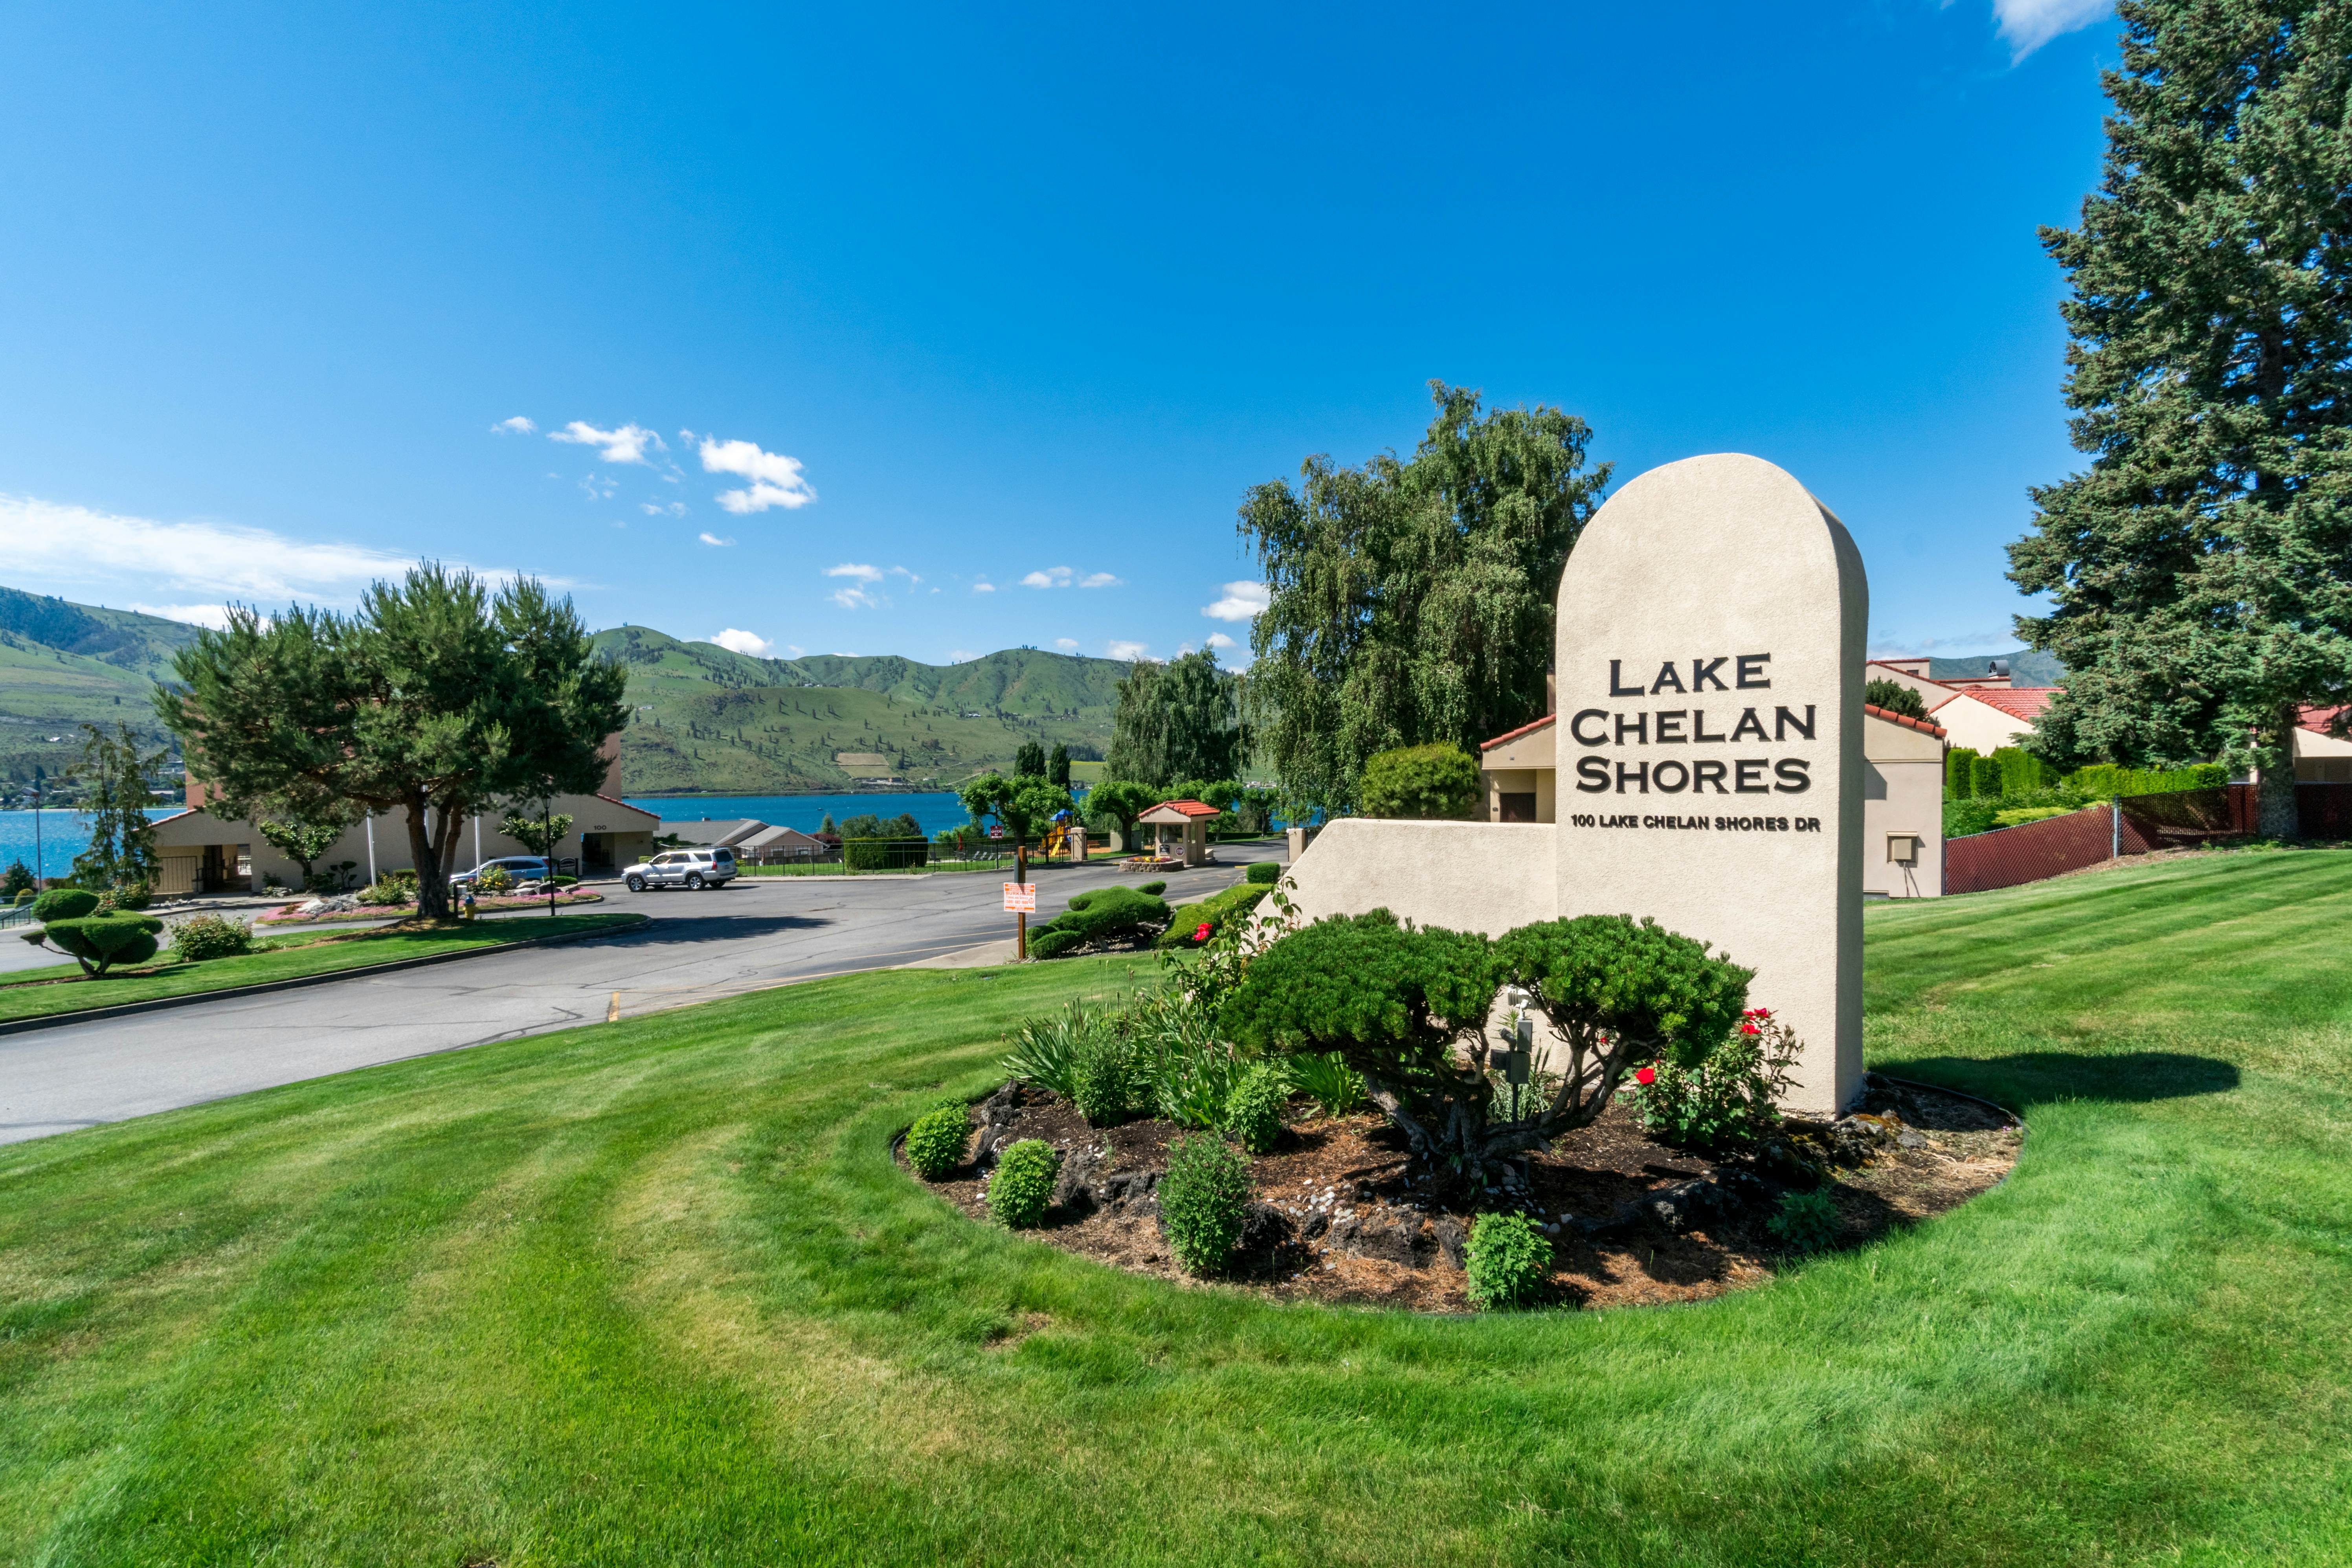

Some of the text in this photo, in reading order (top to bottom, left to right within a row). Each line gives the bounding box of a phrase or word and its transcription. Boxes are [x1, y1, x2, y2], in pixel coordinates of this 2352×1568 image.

[1609, 652, 1770, 696] LAKE
[1571, 705, 1816, 746] CHELAN
[1576, 756, 1810, 795] SHORES
[1571, 814, 1821, 832] 100 LAKE CHELAN SHORES DR
